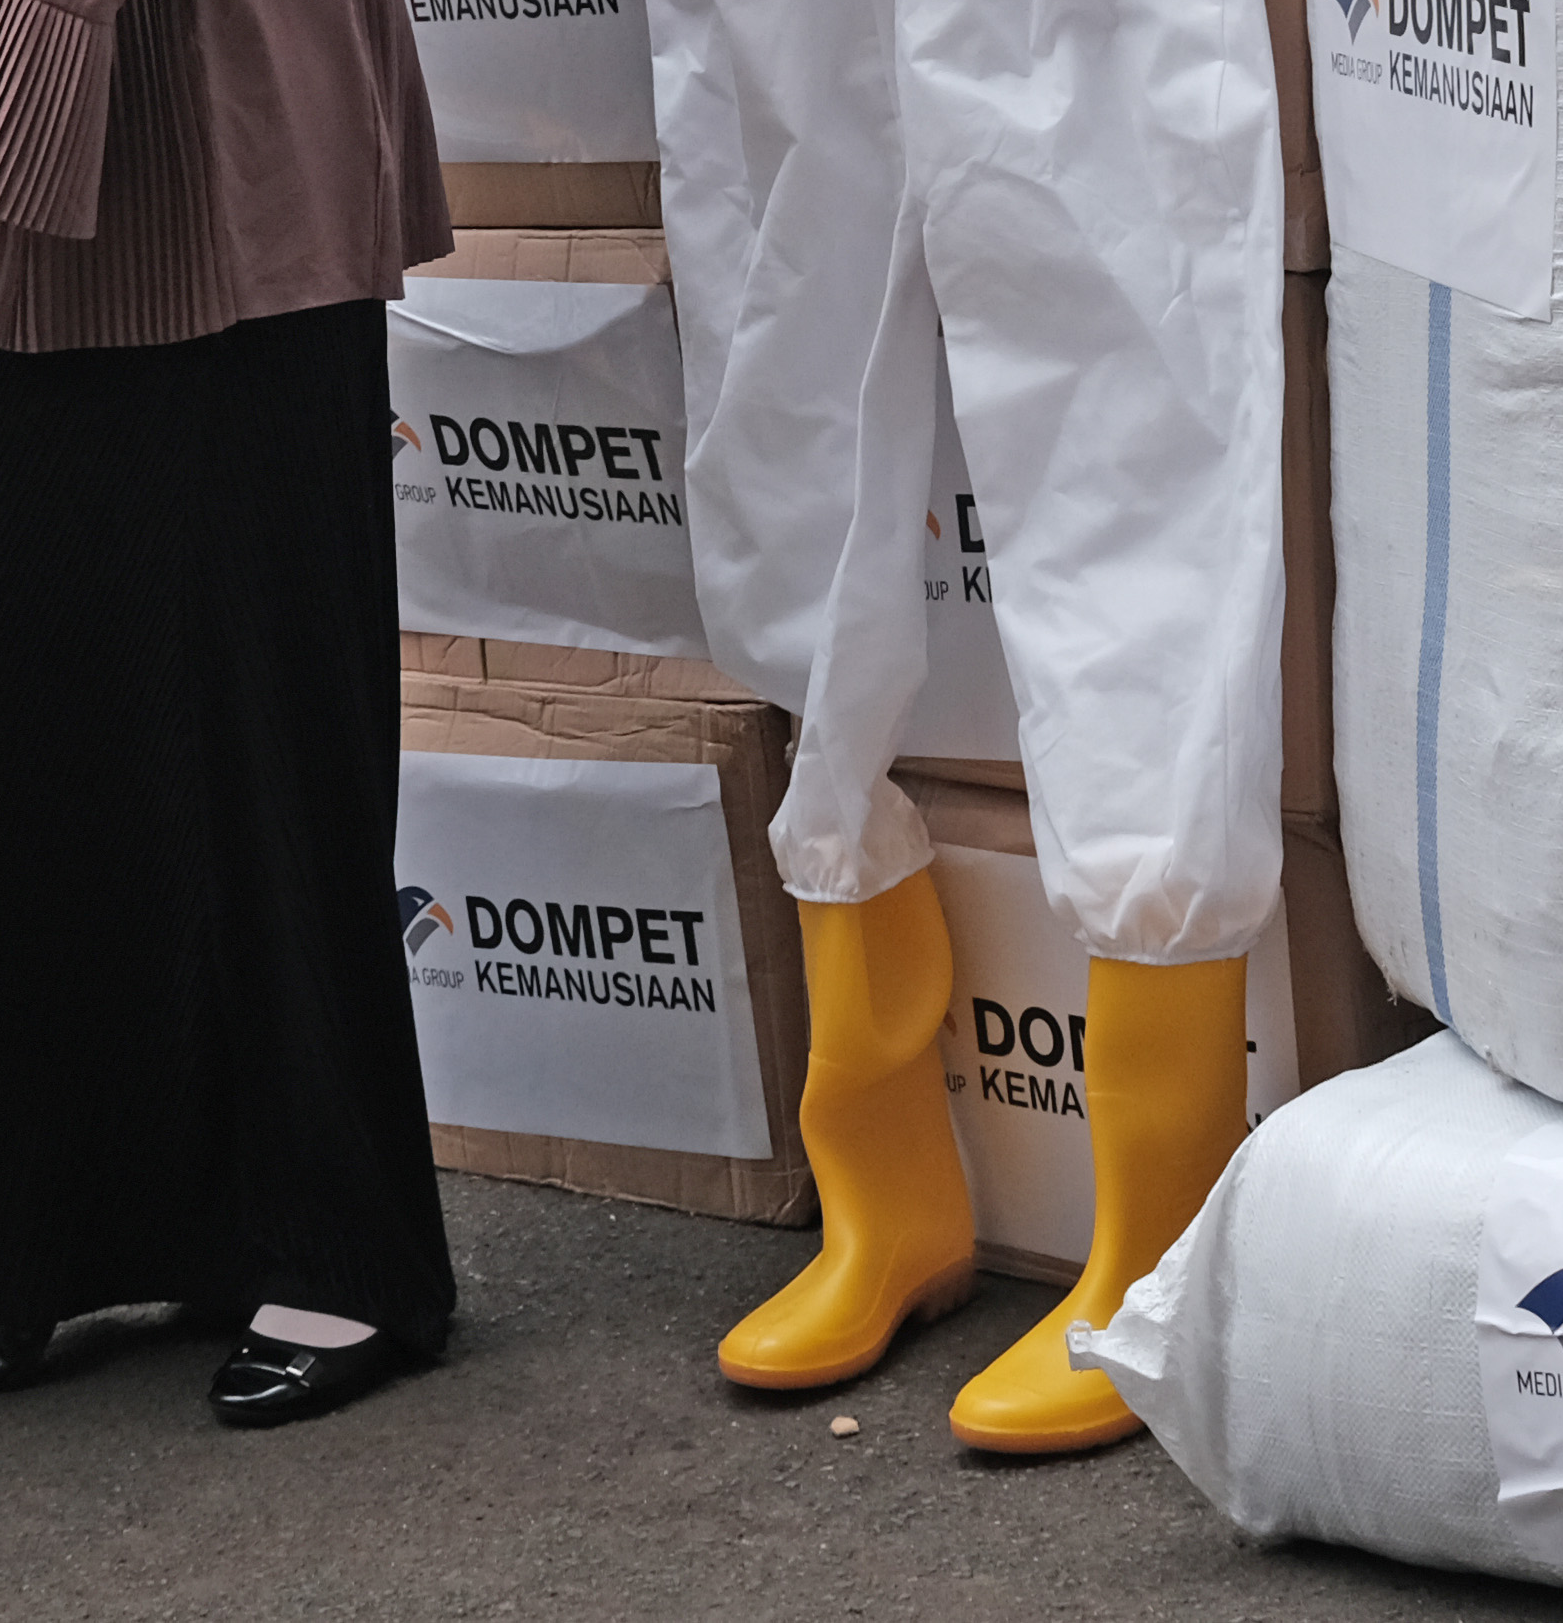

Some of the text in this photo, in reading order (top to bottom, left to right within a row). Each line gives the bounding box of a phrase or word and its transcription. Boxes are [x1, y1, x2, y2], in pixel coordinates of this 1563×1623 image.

[1389, 50, 1534, 128] KEMANUSIAAN
[429, 414, 663, 481] DOMPET
[394, 483, 436, 505] GROUP
[445, 476, 683, 527] KEMANUSIAAN
[465, 895, 704, 966] DOMPET
[422, 968, 465, 989] GROUP
[475, 960, 716, 1013] KEMANUSIAAN
